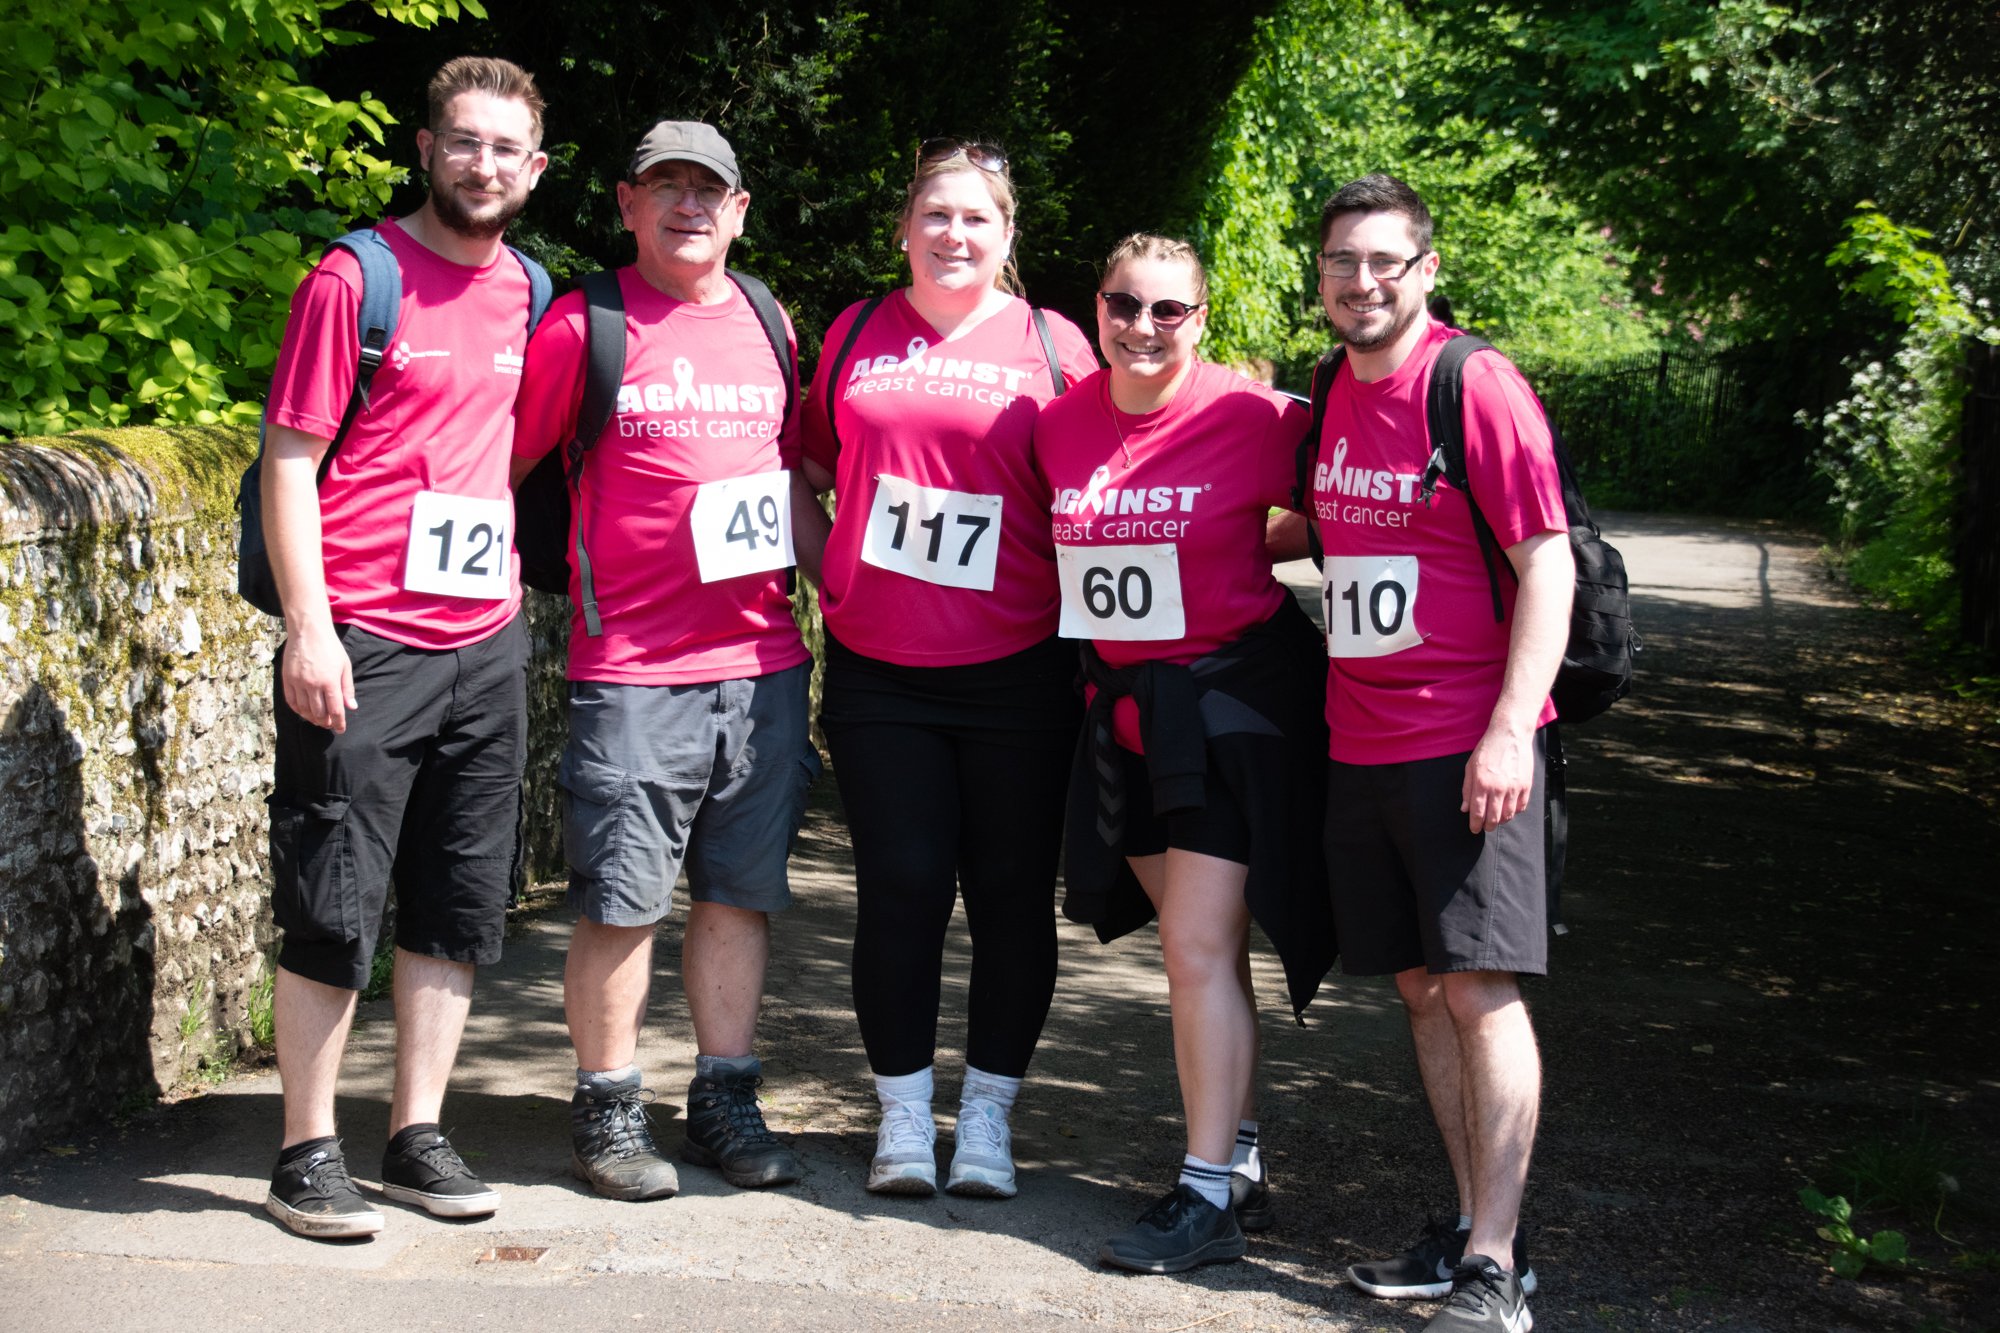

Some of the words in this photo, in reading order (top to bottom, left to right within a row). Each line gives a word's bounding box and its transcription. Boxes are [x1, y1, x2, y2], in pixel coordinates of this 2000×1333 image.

[843, 374, 915, 402] breast
[925, 380, 1017, 409] cancer
[616, 415, 700, 438] breast
[706, 419, 777, 438] cancer
[1313, 437, 1421, 503] GAINST
[725, 495, 780, 551] 49
[887, 501, 991, 567] 117
[1051, 519, 1094, 541] reast
[1102, 519, 1191, 539] cancer
[1343, 504, 1413, 528] cancer
[1082, 565, 1153, 620] 60
[1324, 579, 1407, 636] 110
